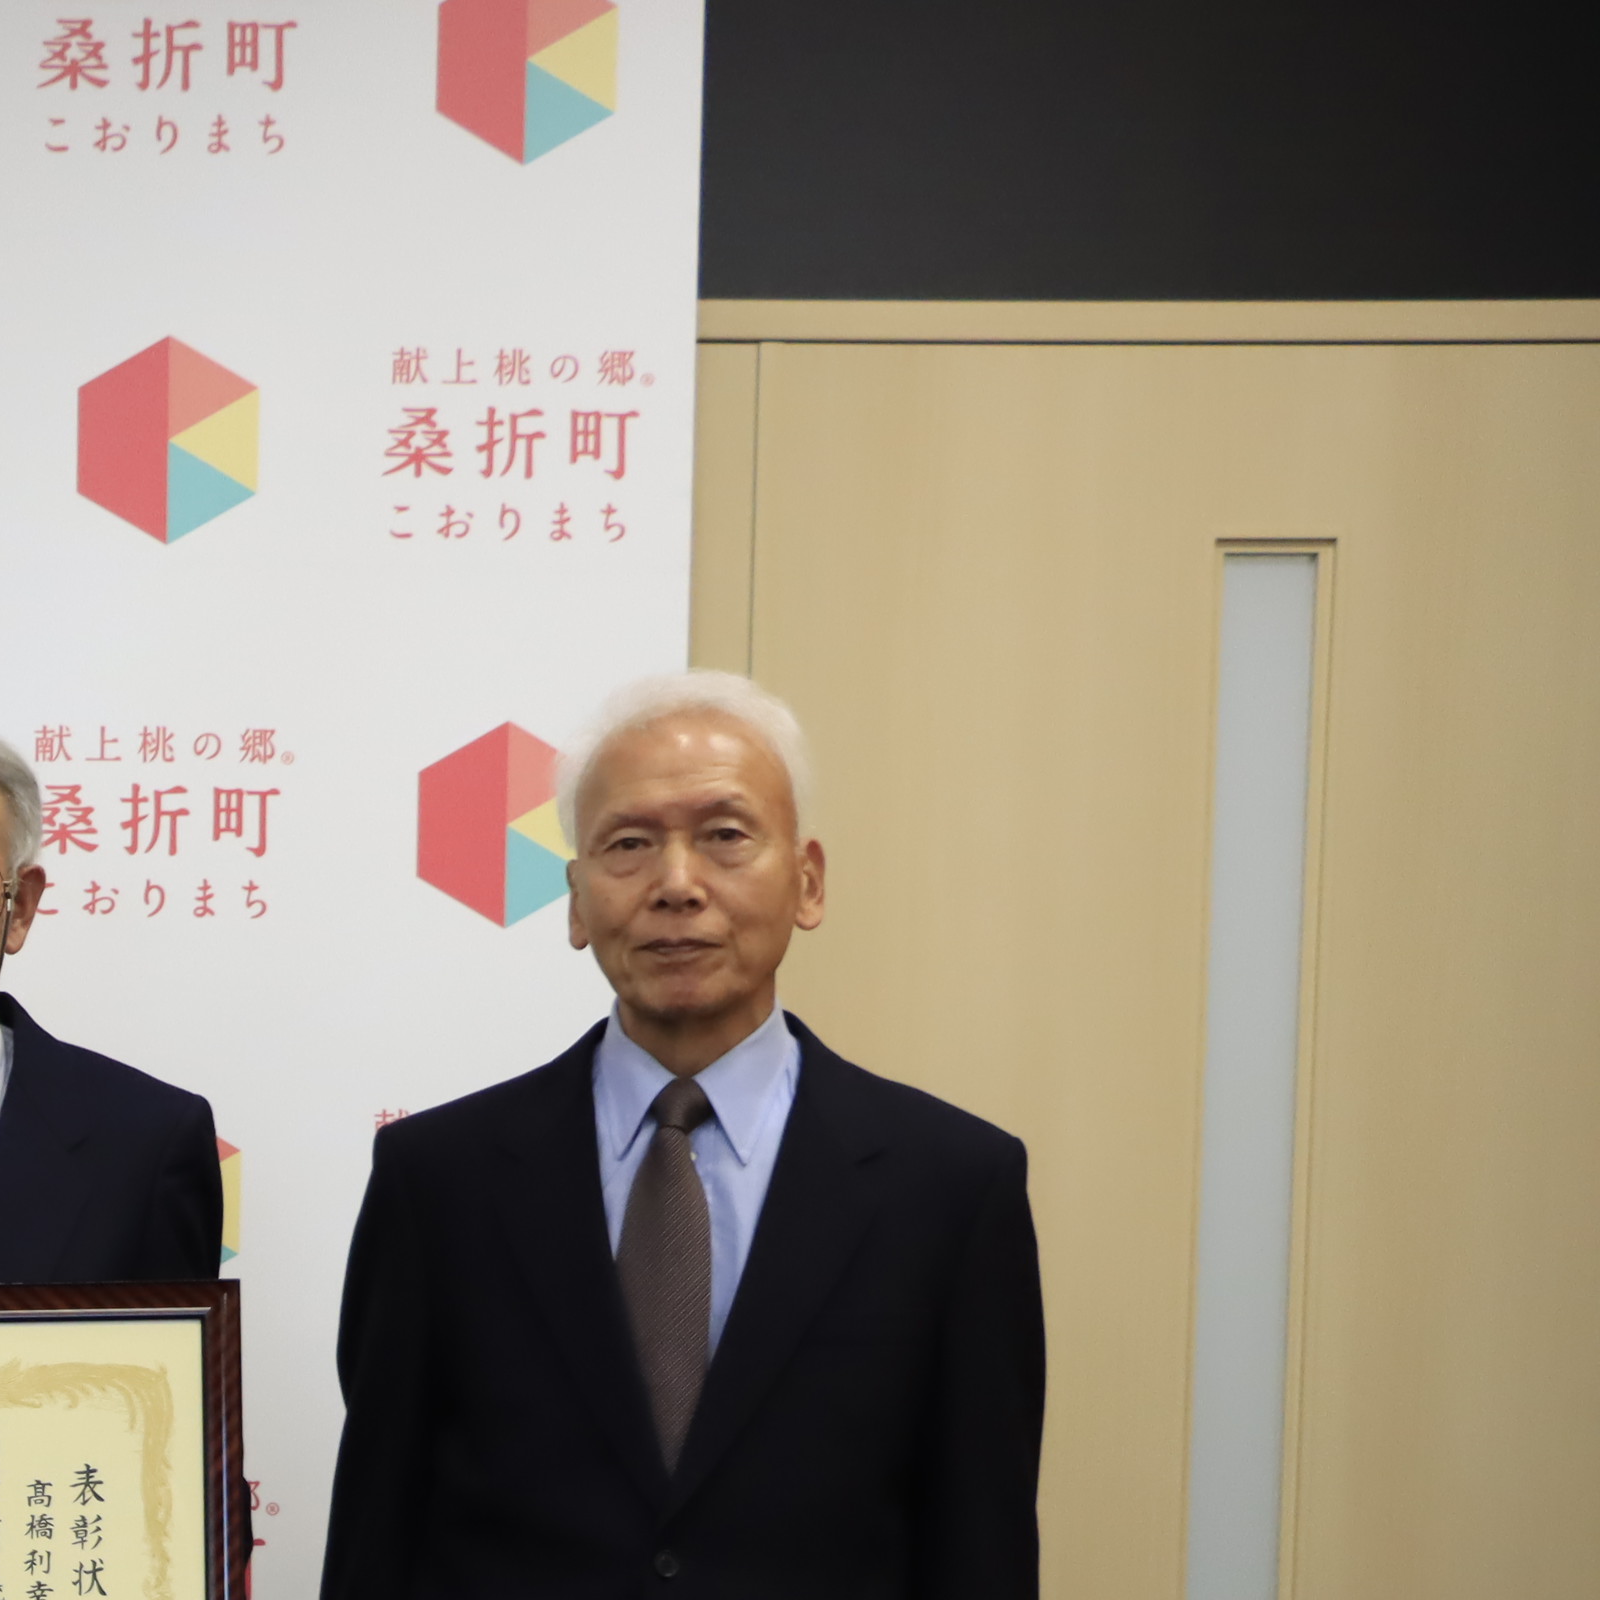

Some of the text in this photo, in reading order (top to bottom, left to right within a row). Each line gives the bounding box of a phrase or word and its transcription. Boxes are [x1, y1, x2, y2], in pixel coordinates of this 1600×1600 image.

[39, 17, 298, 92] 桑折町
[48, 116, 286, 154] こおりまち
[384, 406, 641, 480] 桑折町
[392, 504, 627, 542] こおりまち
[42, 783, 282, 857] 桑折町
[32, 878, 268, 920] こおりまち
[70, 1463, 108, 1597] 表彰状
